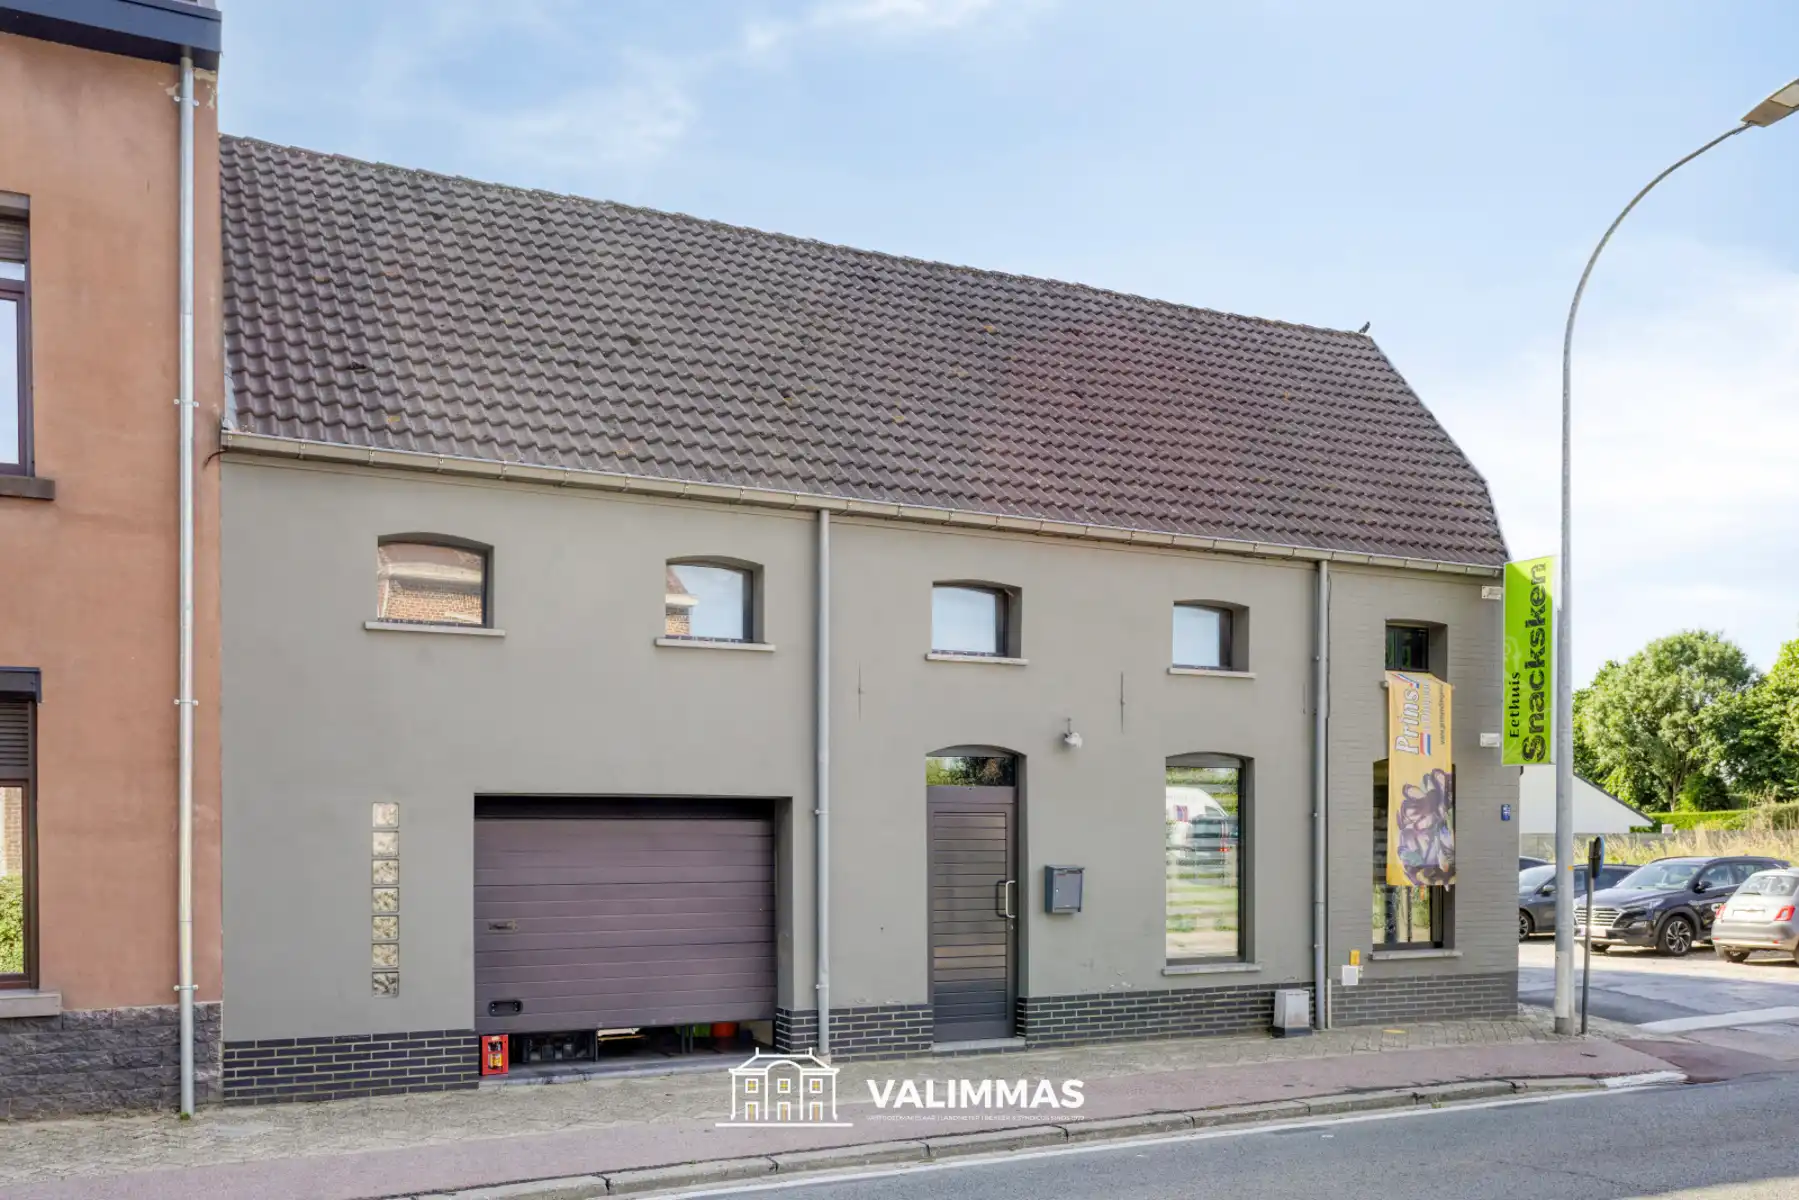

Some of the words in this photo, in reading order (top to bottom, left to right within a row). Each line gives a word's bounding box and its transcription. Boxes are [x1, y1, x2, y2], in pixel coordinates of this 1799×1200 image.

[1521, 562, 1547, 763] Snacksken
[1395, 687, 1420, 755] Prins
[1508, 671, 1521, 738] Eethuis
